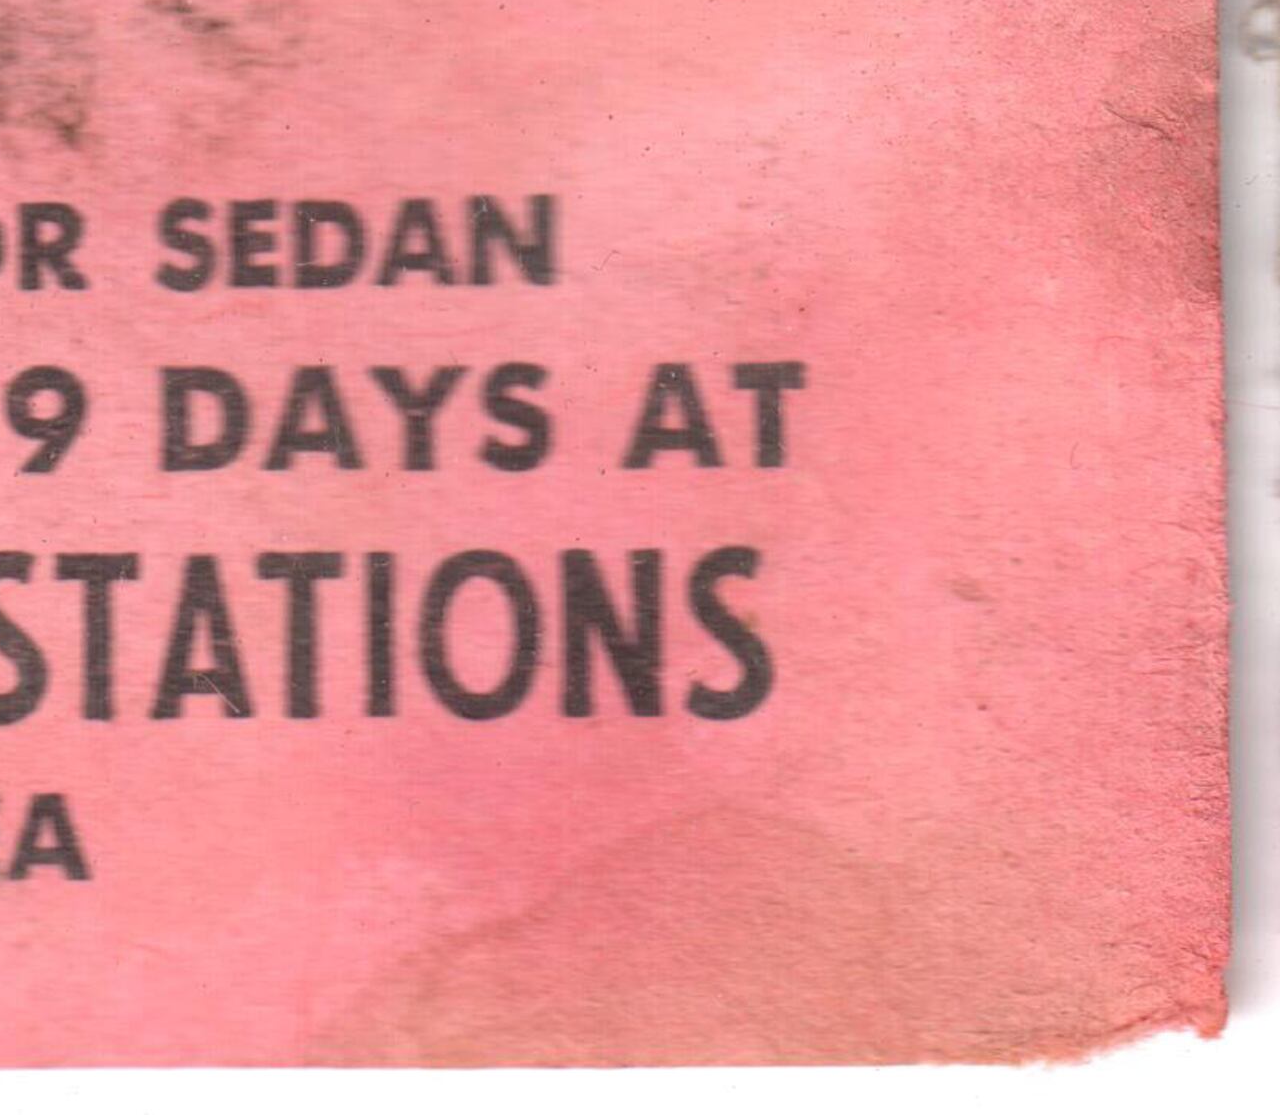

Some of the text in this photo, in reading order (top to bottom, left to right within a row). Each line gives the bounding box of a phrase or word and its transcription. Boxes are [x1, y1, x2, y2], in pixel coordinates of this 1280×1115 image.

[155, 194, 556, 293] SEDAN
[161, 361, 552, 473] DAYS
[621, 361, 805, 470] AT
